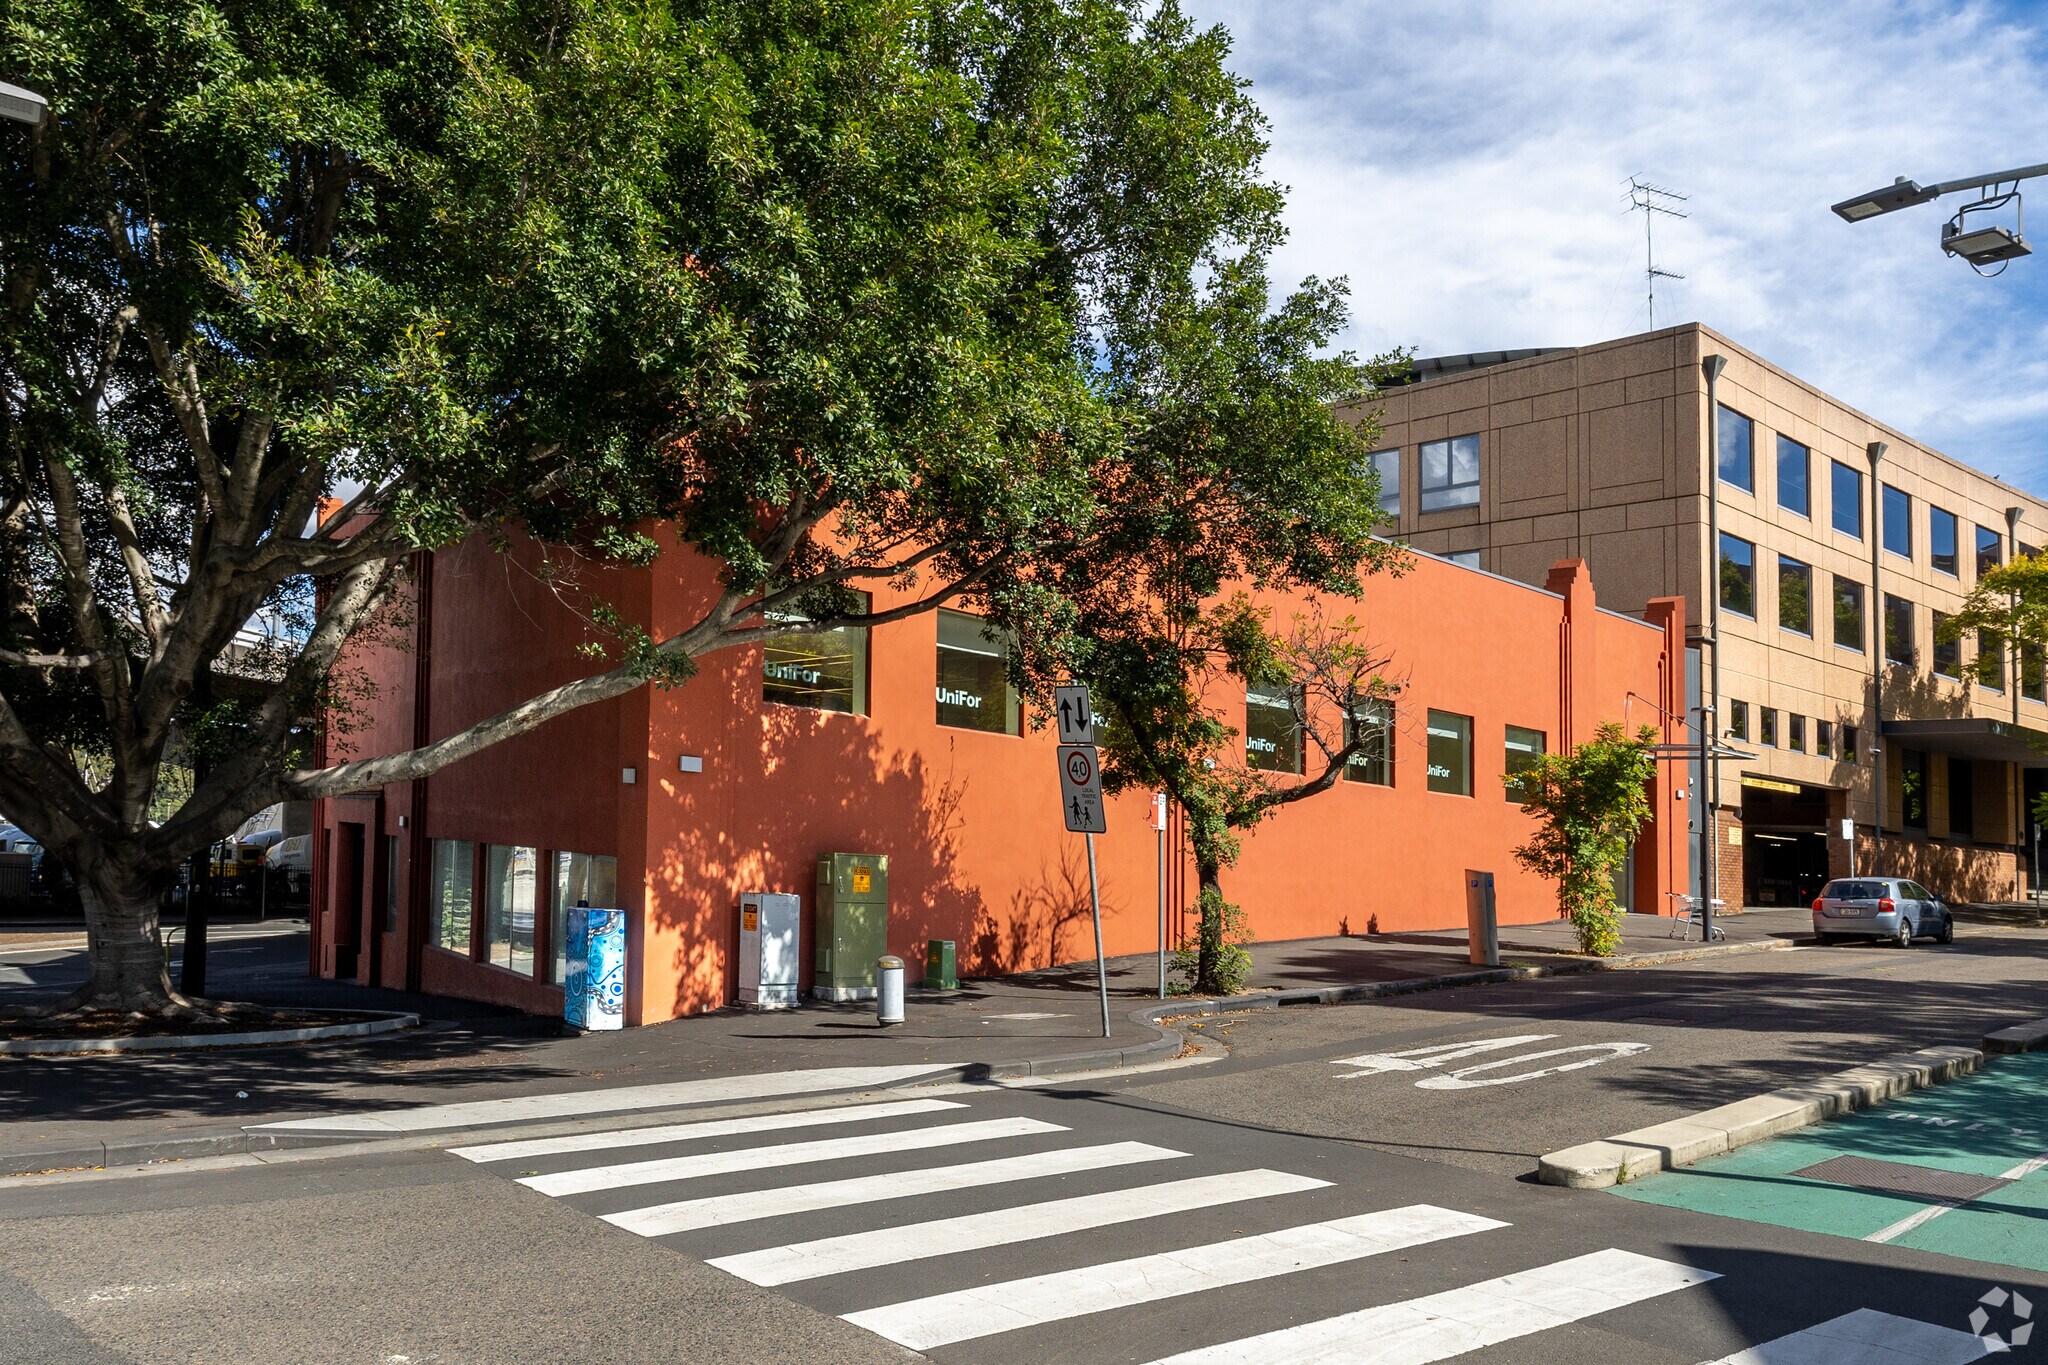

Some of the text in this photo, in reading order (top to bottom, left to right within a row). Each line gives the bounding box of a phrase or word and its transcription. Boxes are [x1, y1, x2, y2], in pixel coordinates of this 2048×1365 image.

[764, 659, 821, 684] UniFor
[935, 686, 982, 708] UniFor
[1245, 736, 1276, 753] UniFor
[1071, 761, 1087, 776] 40
[1329, 1034, 1653, 1091] 40
[1886, 1112, 2039, 1137] ONLY
